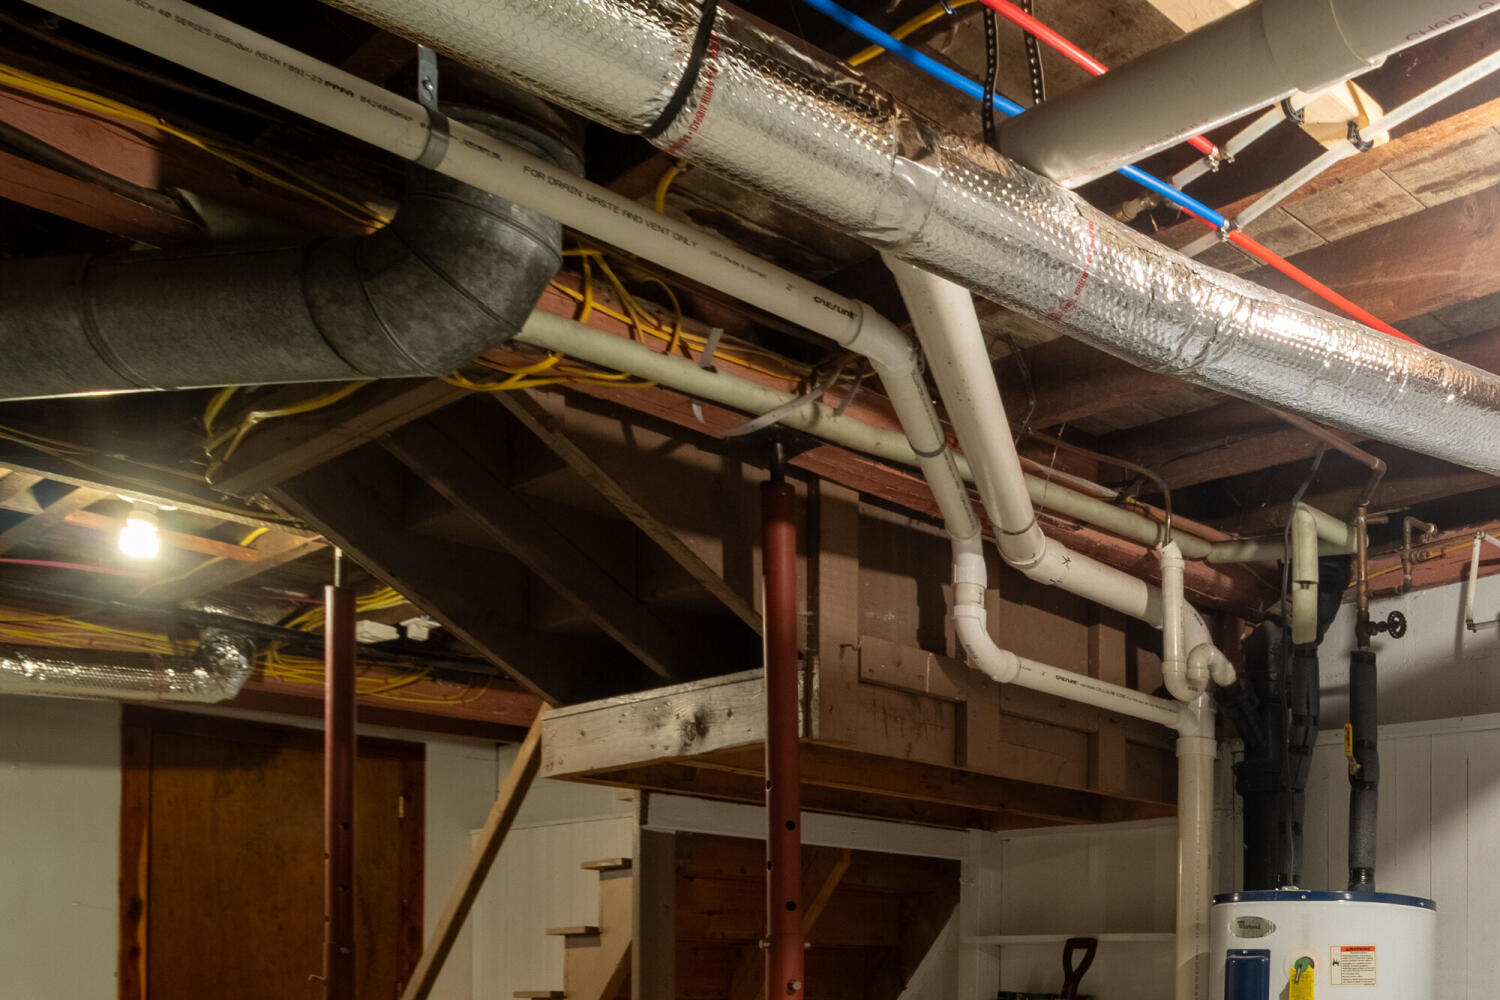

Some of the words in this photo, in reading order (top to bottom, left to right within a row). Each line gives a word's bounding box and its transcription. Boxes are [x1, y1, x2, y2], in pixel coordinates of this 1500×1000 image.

[523, 165, 545, 181] FOR
[586, 193, 620, 215] WASTE
[621, 207, 644, 225] AND
[645, 219, 671, 238] VENT
[672, 231, 699, 248] ONLY
